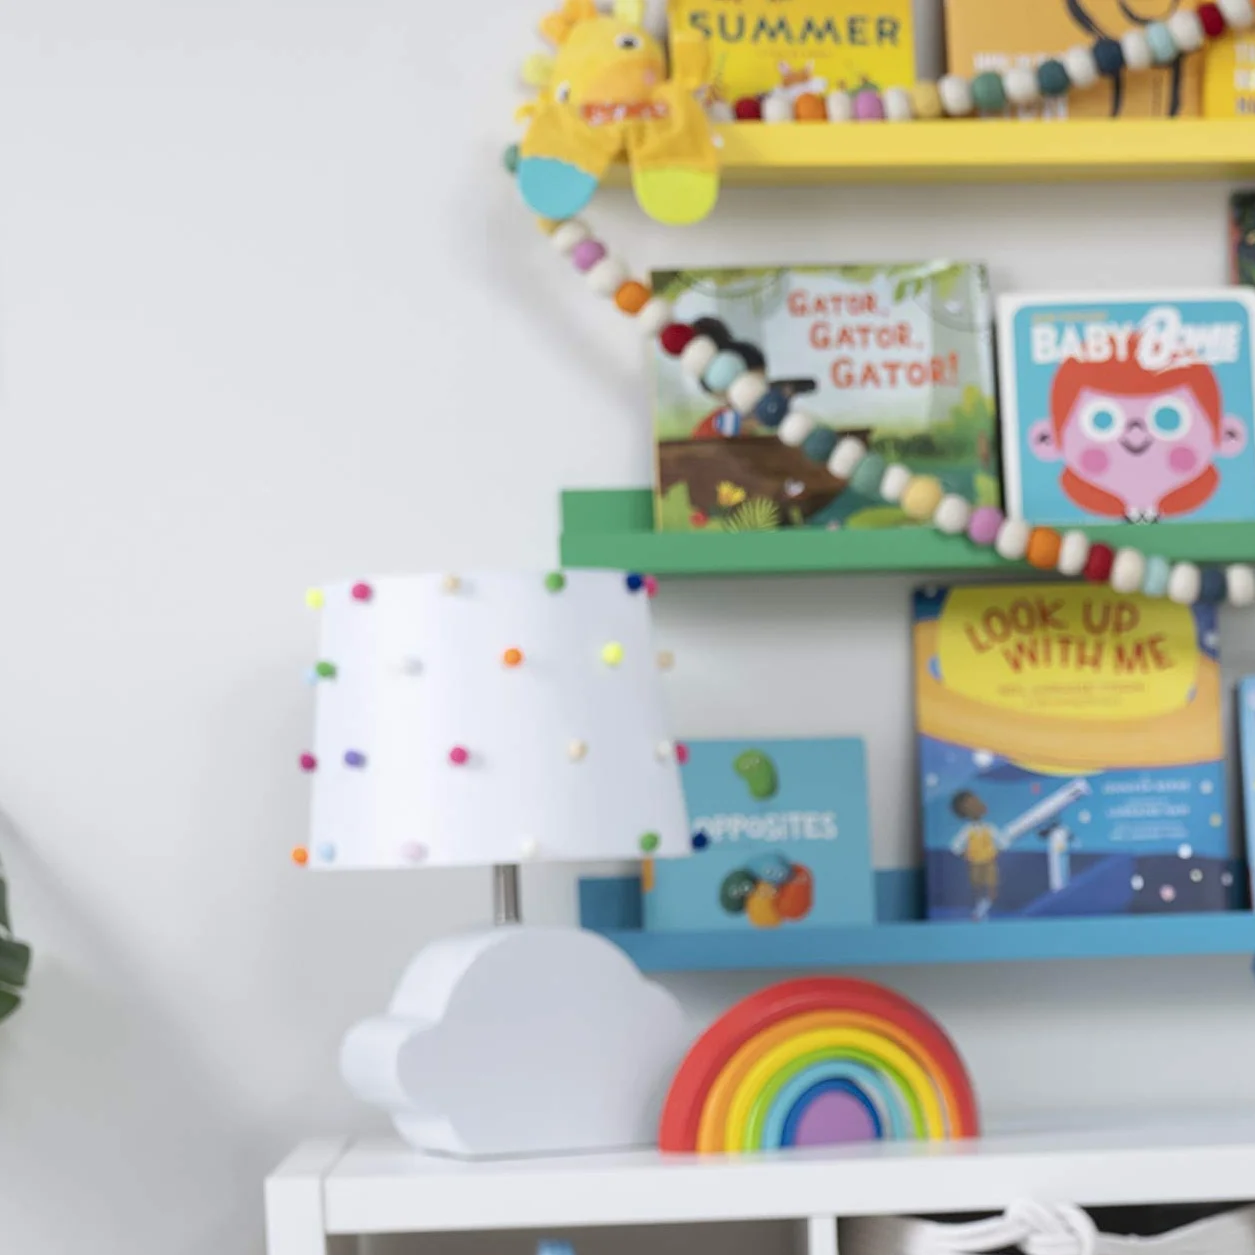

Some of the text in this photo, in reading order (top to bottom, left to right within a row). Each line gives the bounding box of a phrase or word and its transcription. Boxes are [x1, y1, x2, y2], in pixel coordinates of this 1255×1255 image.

[688, 11, 900, 48] SUMMER
[1030, 321, 1133, 365] BABY
[830, 349, 960, 389] GATOR!
[962, 594, 1142, 655] LOOK UP
[1002, 631, 1178, 675] WITH ME
